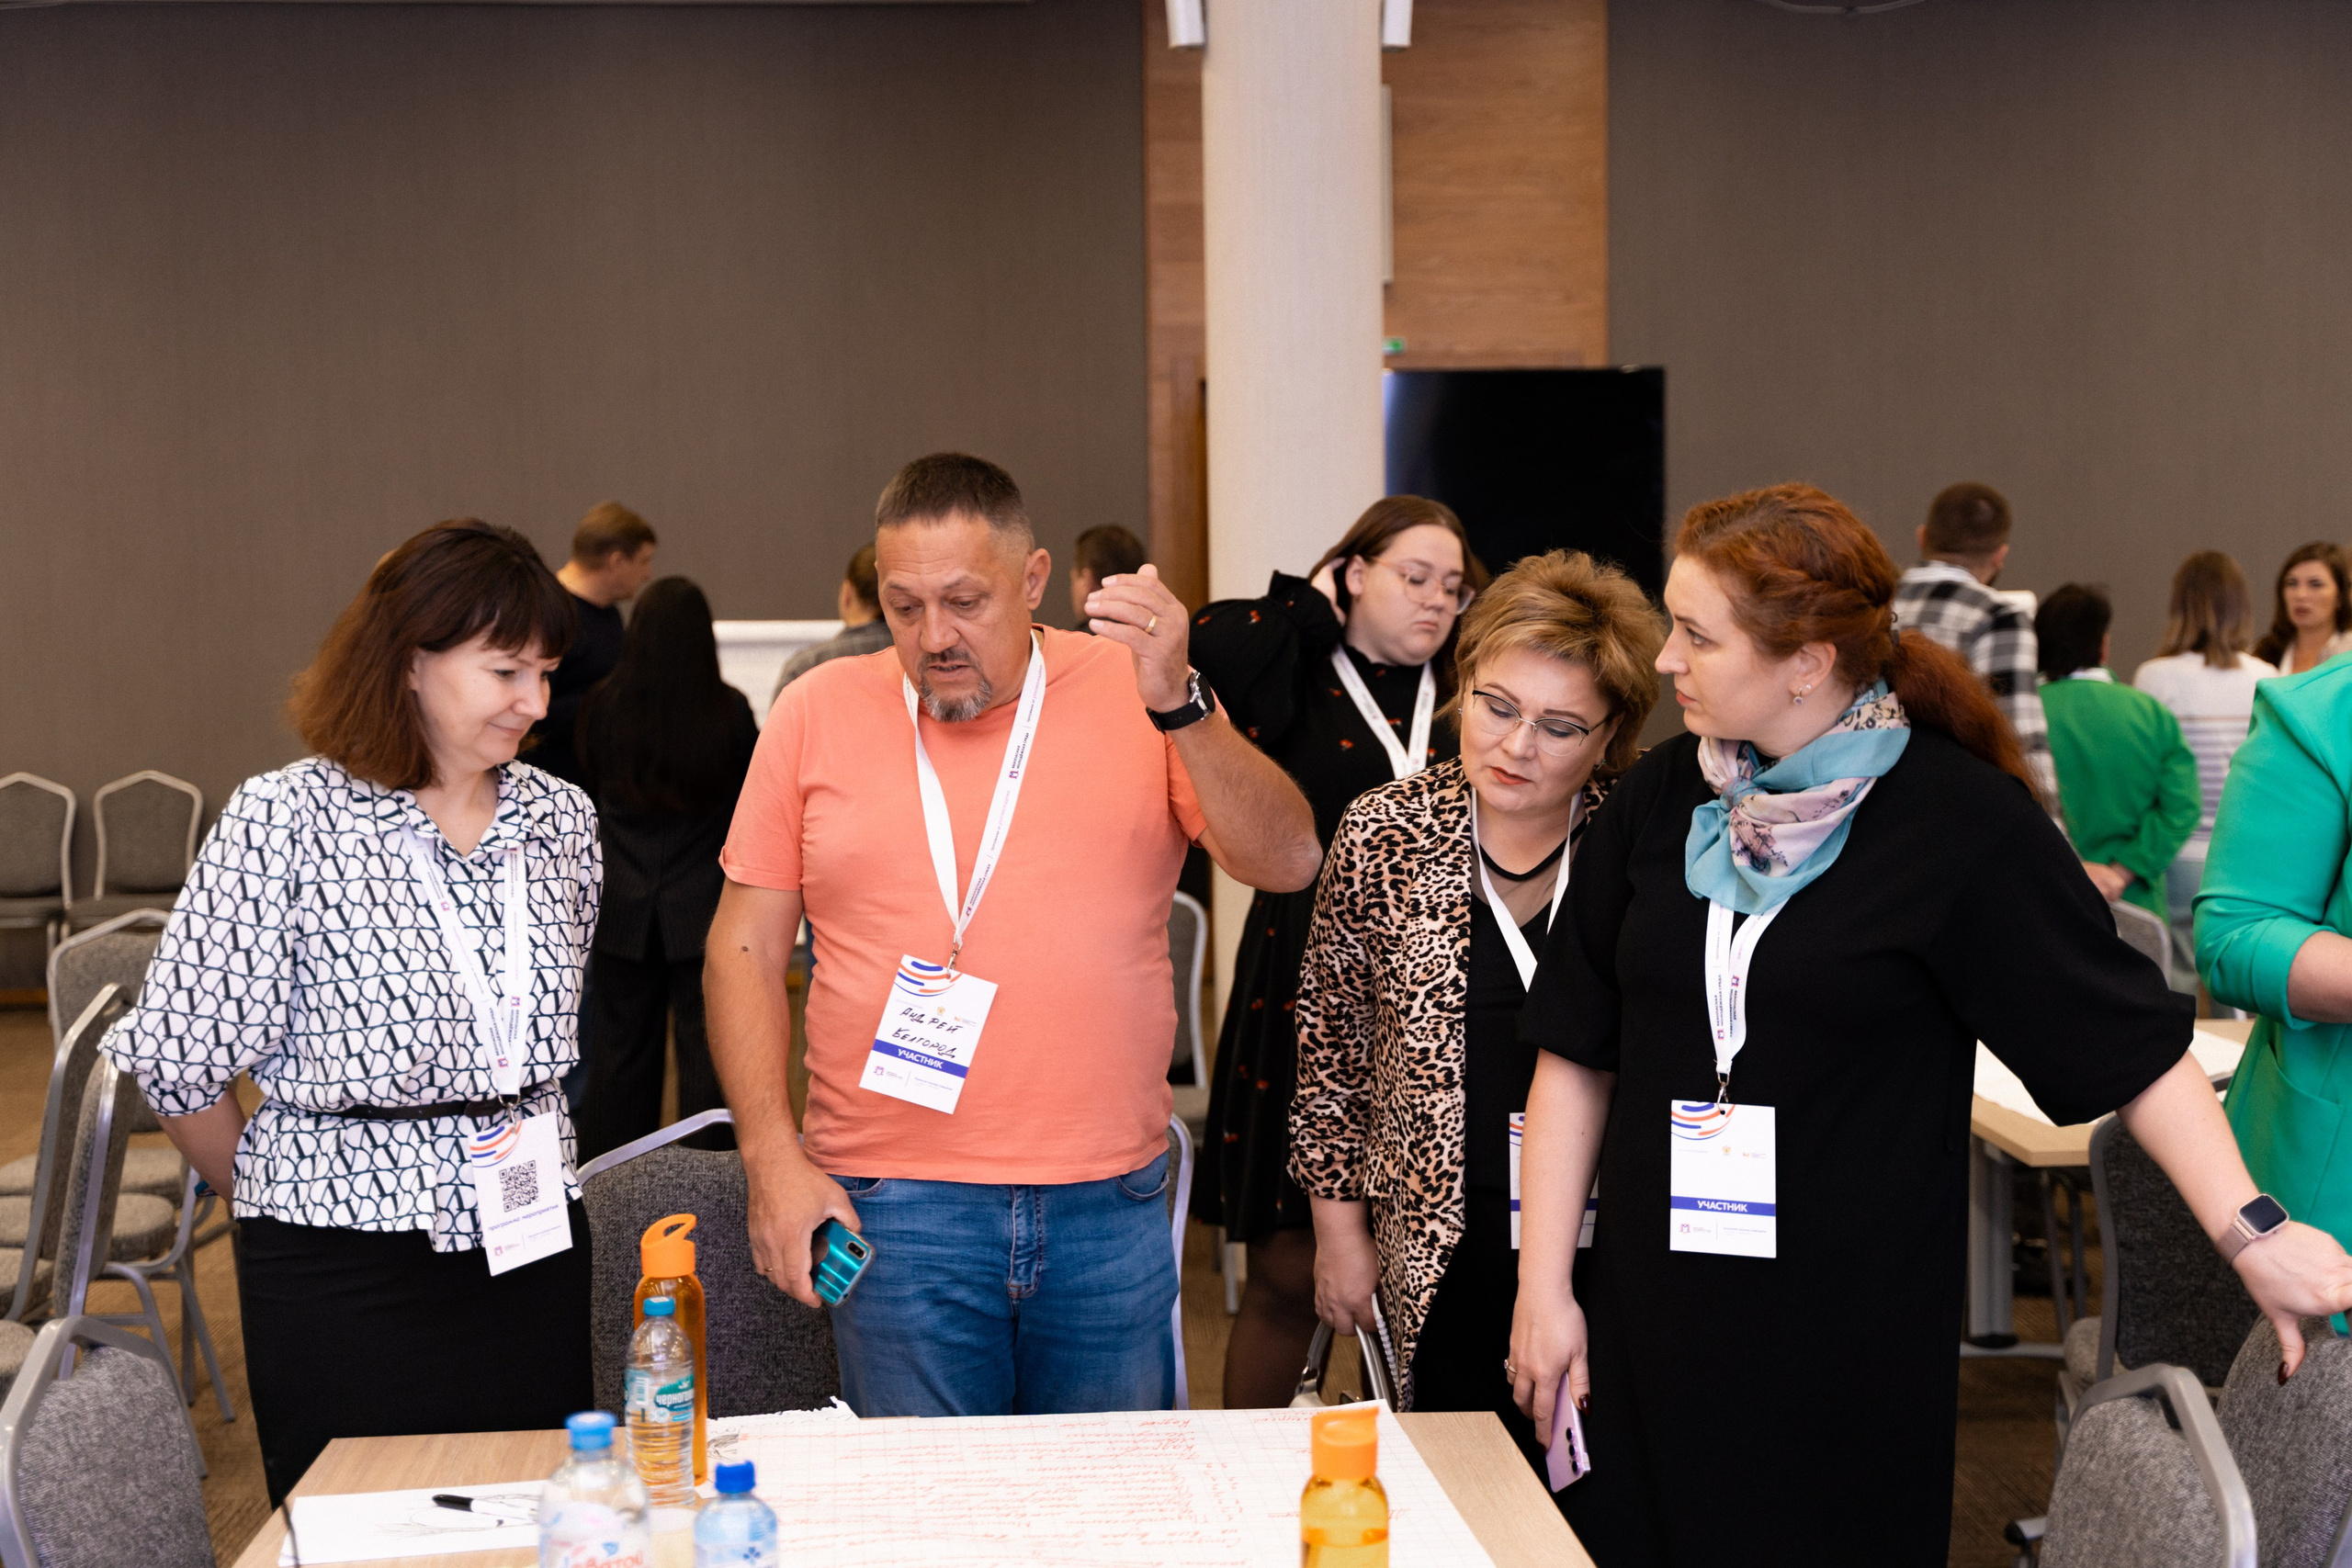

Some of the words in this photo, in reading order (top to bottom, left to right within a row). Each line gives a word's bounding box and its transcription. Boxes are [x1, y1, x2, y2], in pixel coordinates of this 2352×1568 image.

[892, 1027, 957, 1058] БЕЛГОРОД
[898, 1049, 944, 1069] УЧАСТНИК
[1697, 1200, 1747, 1213] УЧАСТНИК
